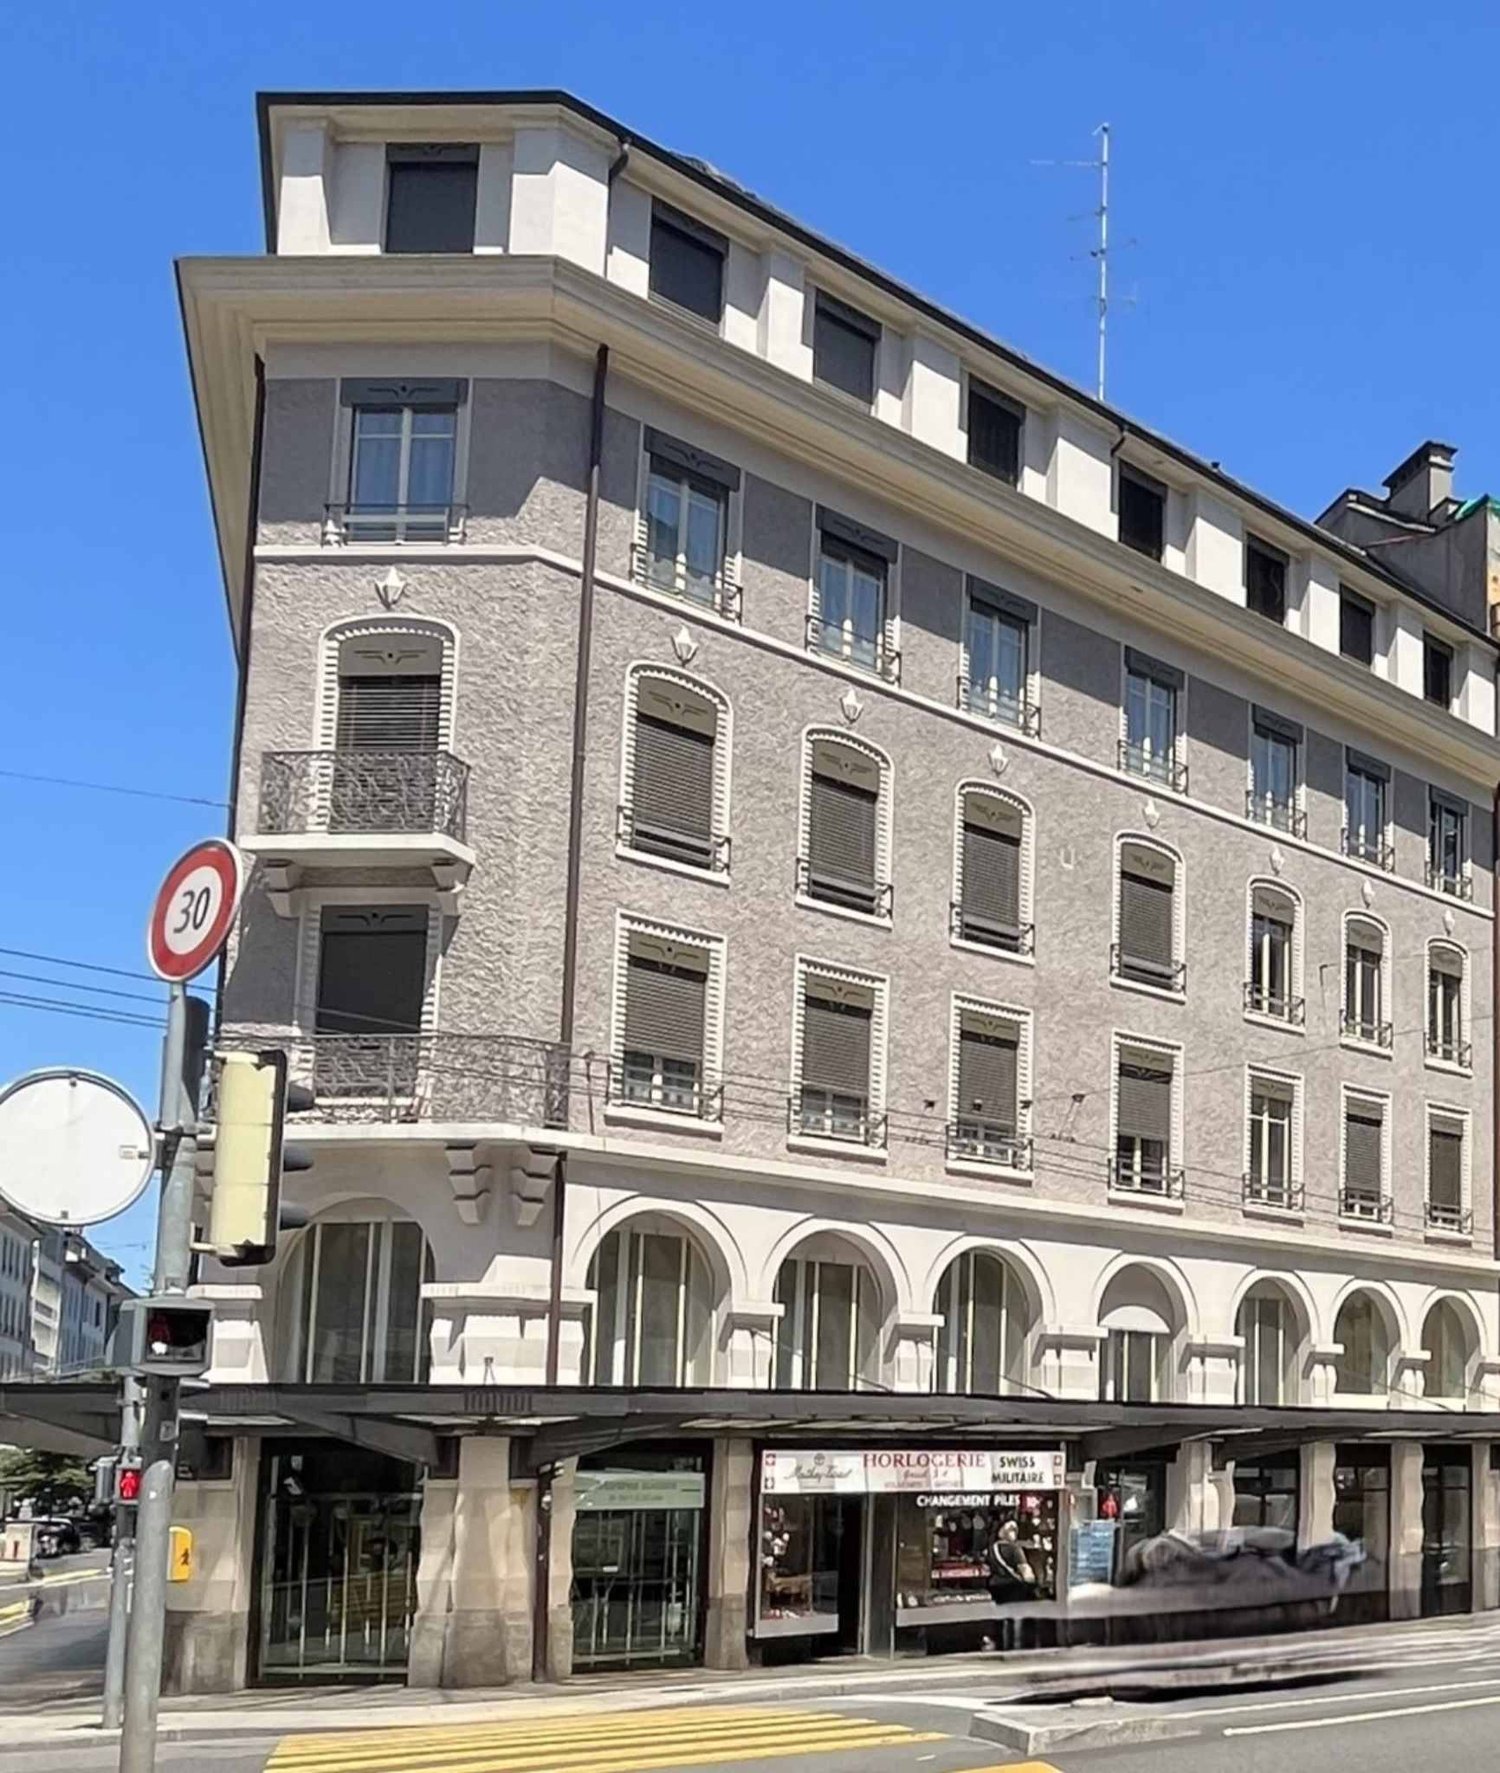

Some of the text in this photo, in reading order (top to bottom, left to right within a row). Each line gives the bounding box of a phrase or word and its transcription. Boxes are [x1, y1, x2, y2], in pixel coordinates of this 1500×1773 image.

[173, 886, 211, 934] 30
[863, 1452, 986, 1468] HORLOGERIE
[999, 1455, 1036, 1468] SWISS
[991, 1471, 1045, 1484] MILITAIRE
[916, 1493, 991, 1507] CHANGEMENT
